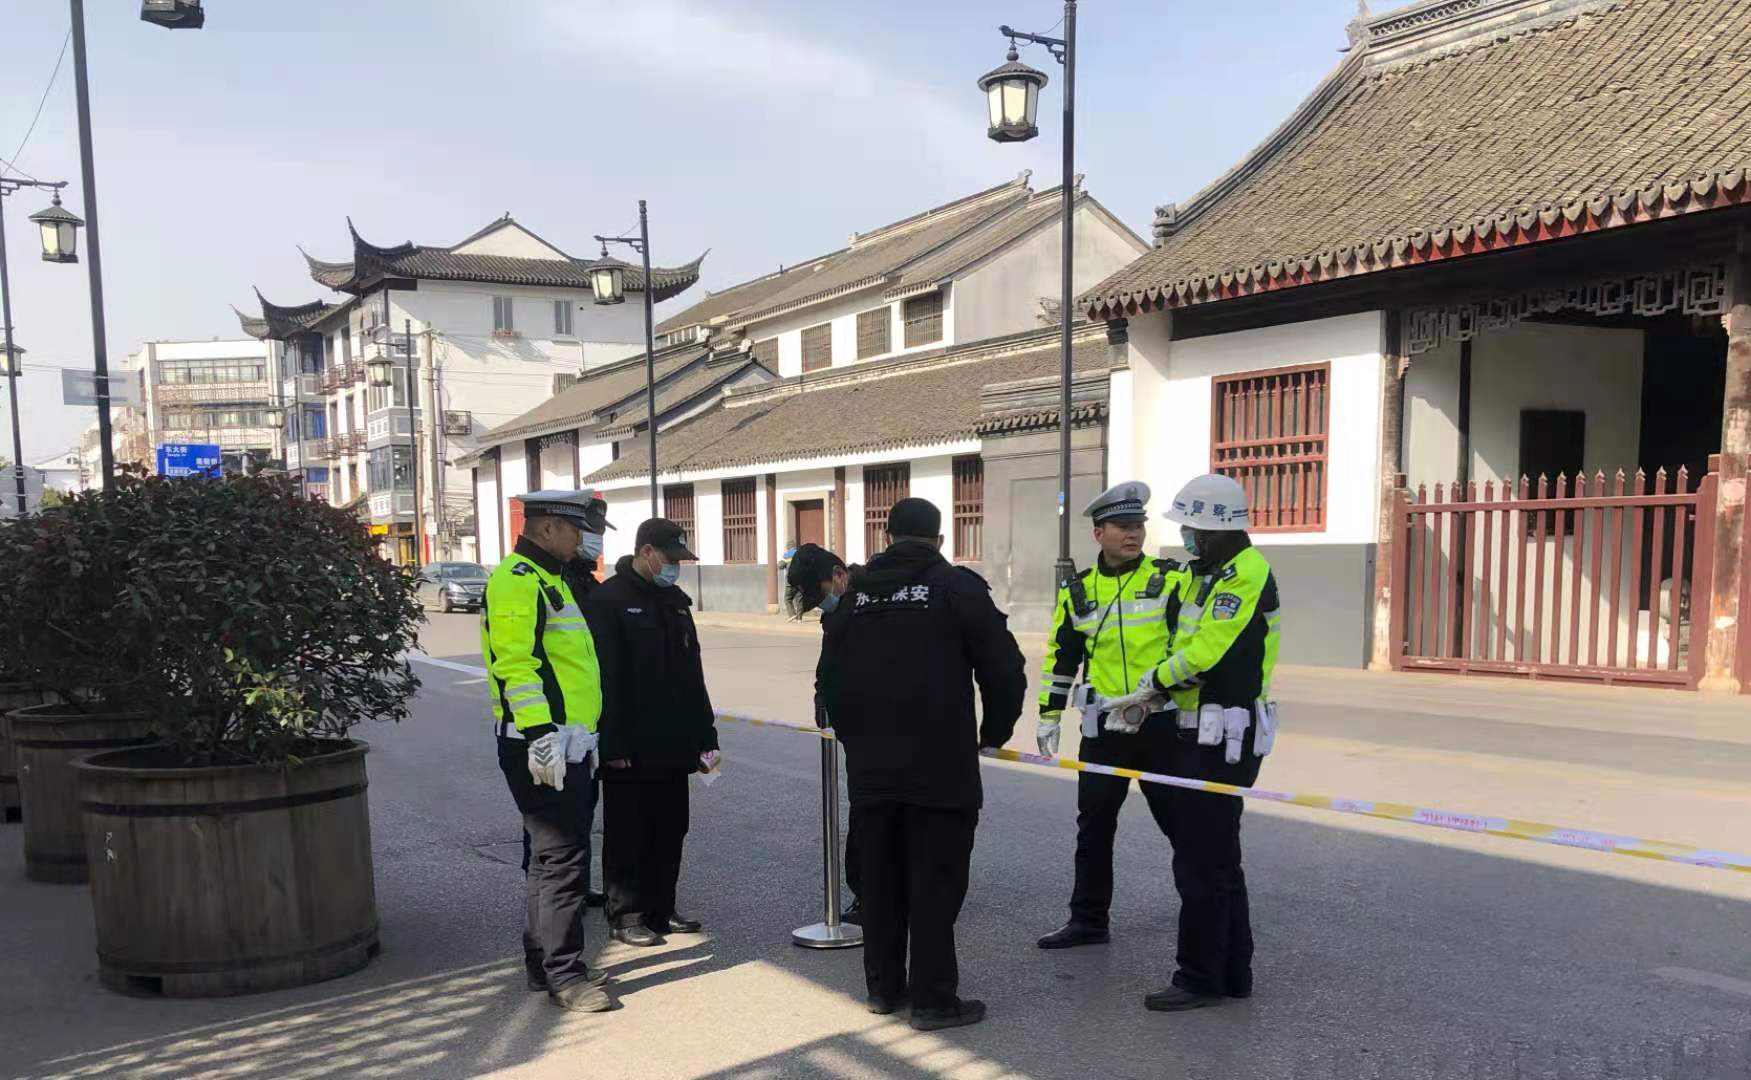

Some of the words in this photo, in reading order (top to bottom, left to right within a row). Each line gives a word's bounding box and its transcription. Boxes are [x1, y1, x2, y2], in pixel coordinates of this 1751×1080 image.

[1192, 500, 1226, 517] 警察
[855, 584, 928, 606] 东保安
